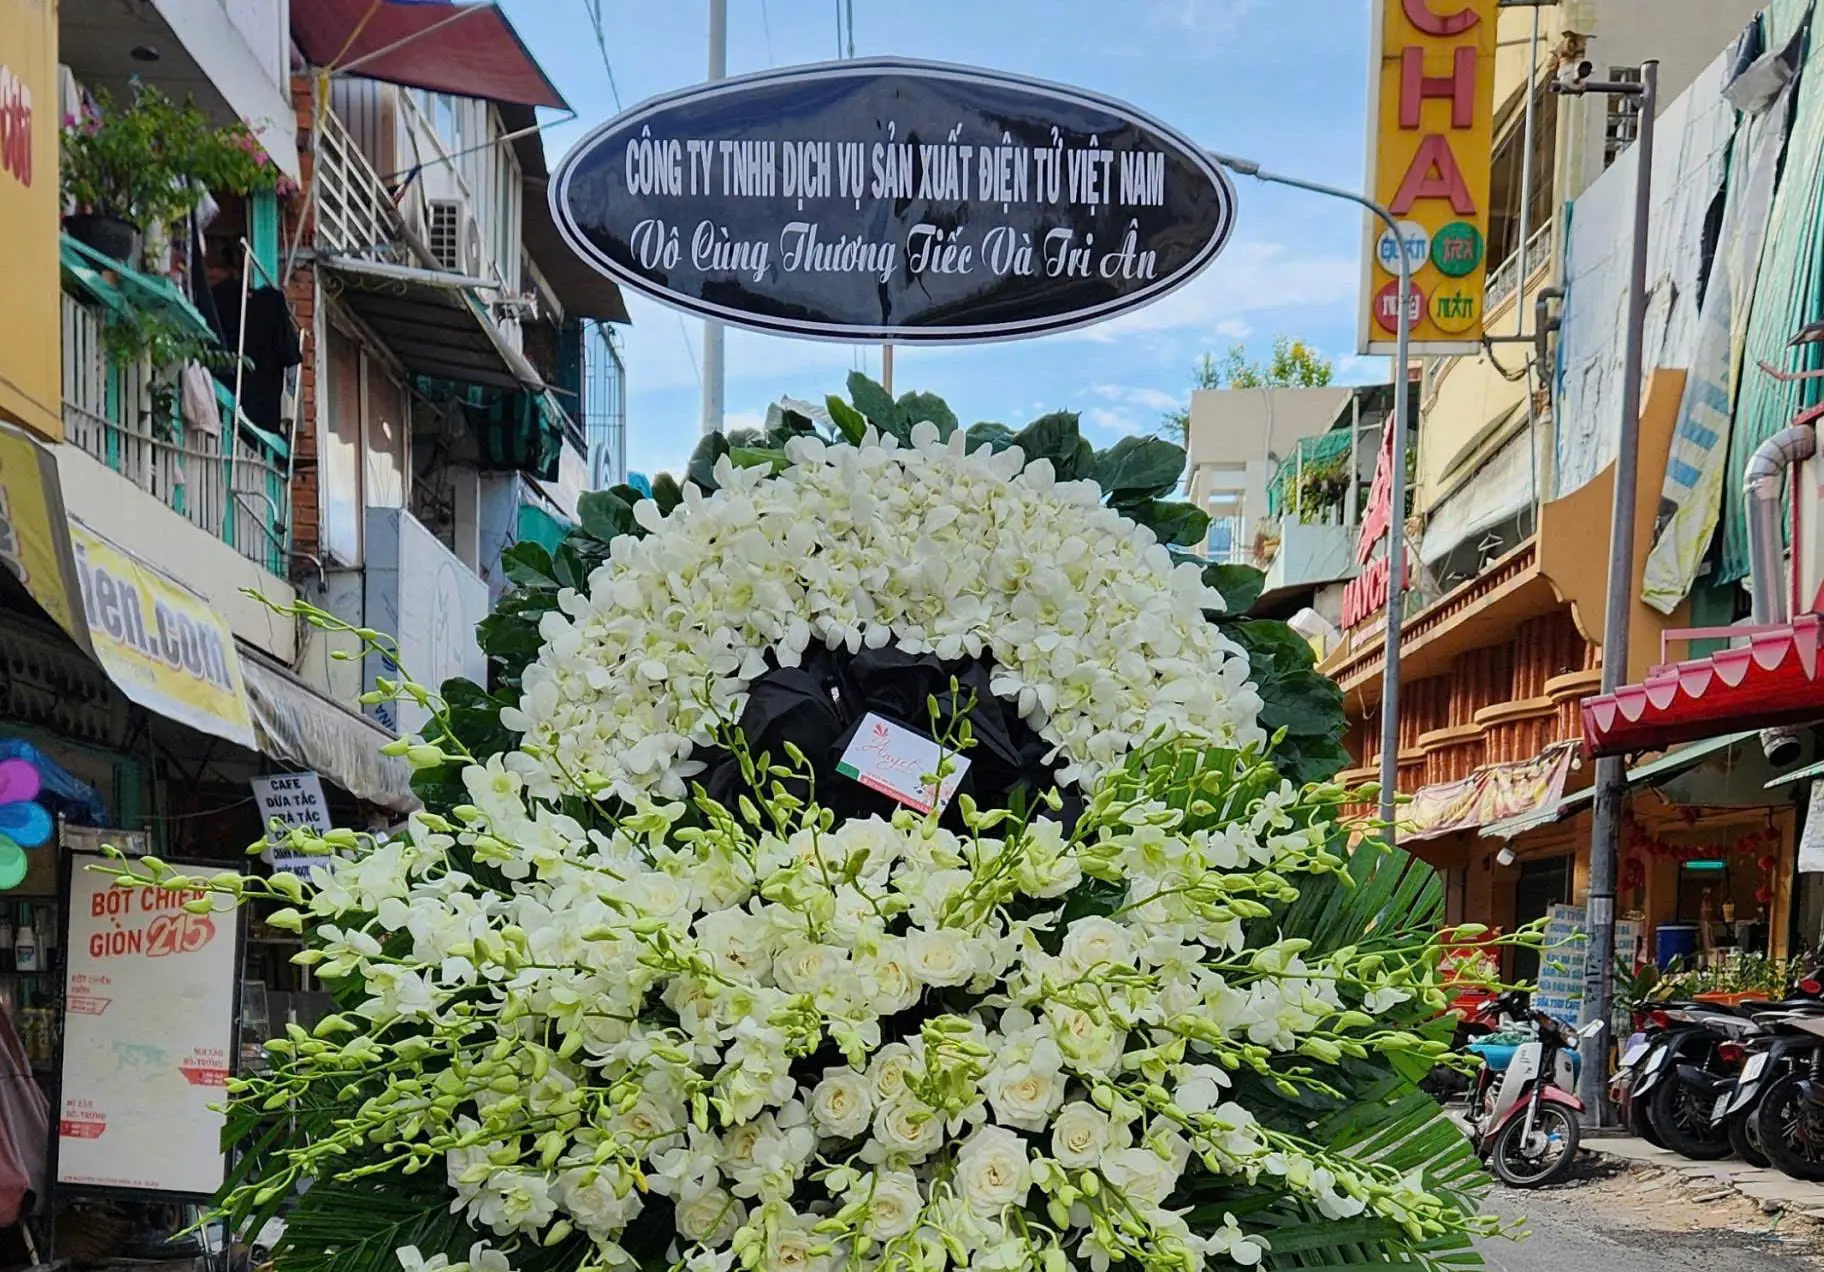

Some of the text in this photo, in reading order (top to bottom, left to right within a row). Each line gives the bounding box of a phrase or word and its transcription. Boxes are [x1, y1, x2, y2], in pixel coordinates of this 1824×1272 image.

[626, 120, 1165, 217] CÔNG TY TNHH DỊCH VỤ SẢN XUẤT ĐIỆN TỬ VIỆT NAM
[630, 218, 1158, 284] Vô Cùng Thương Tiếc Và Tri Ân
[270, 778, 301, 791] CAFE
